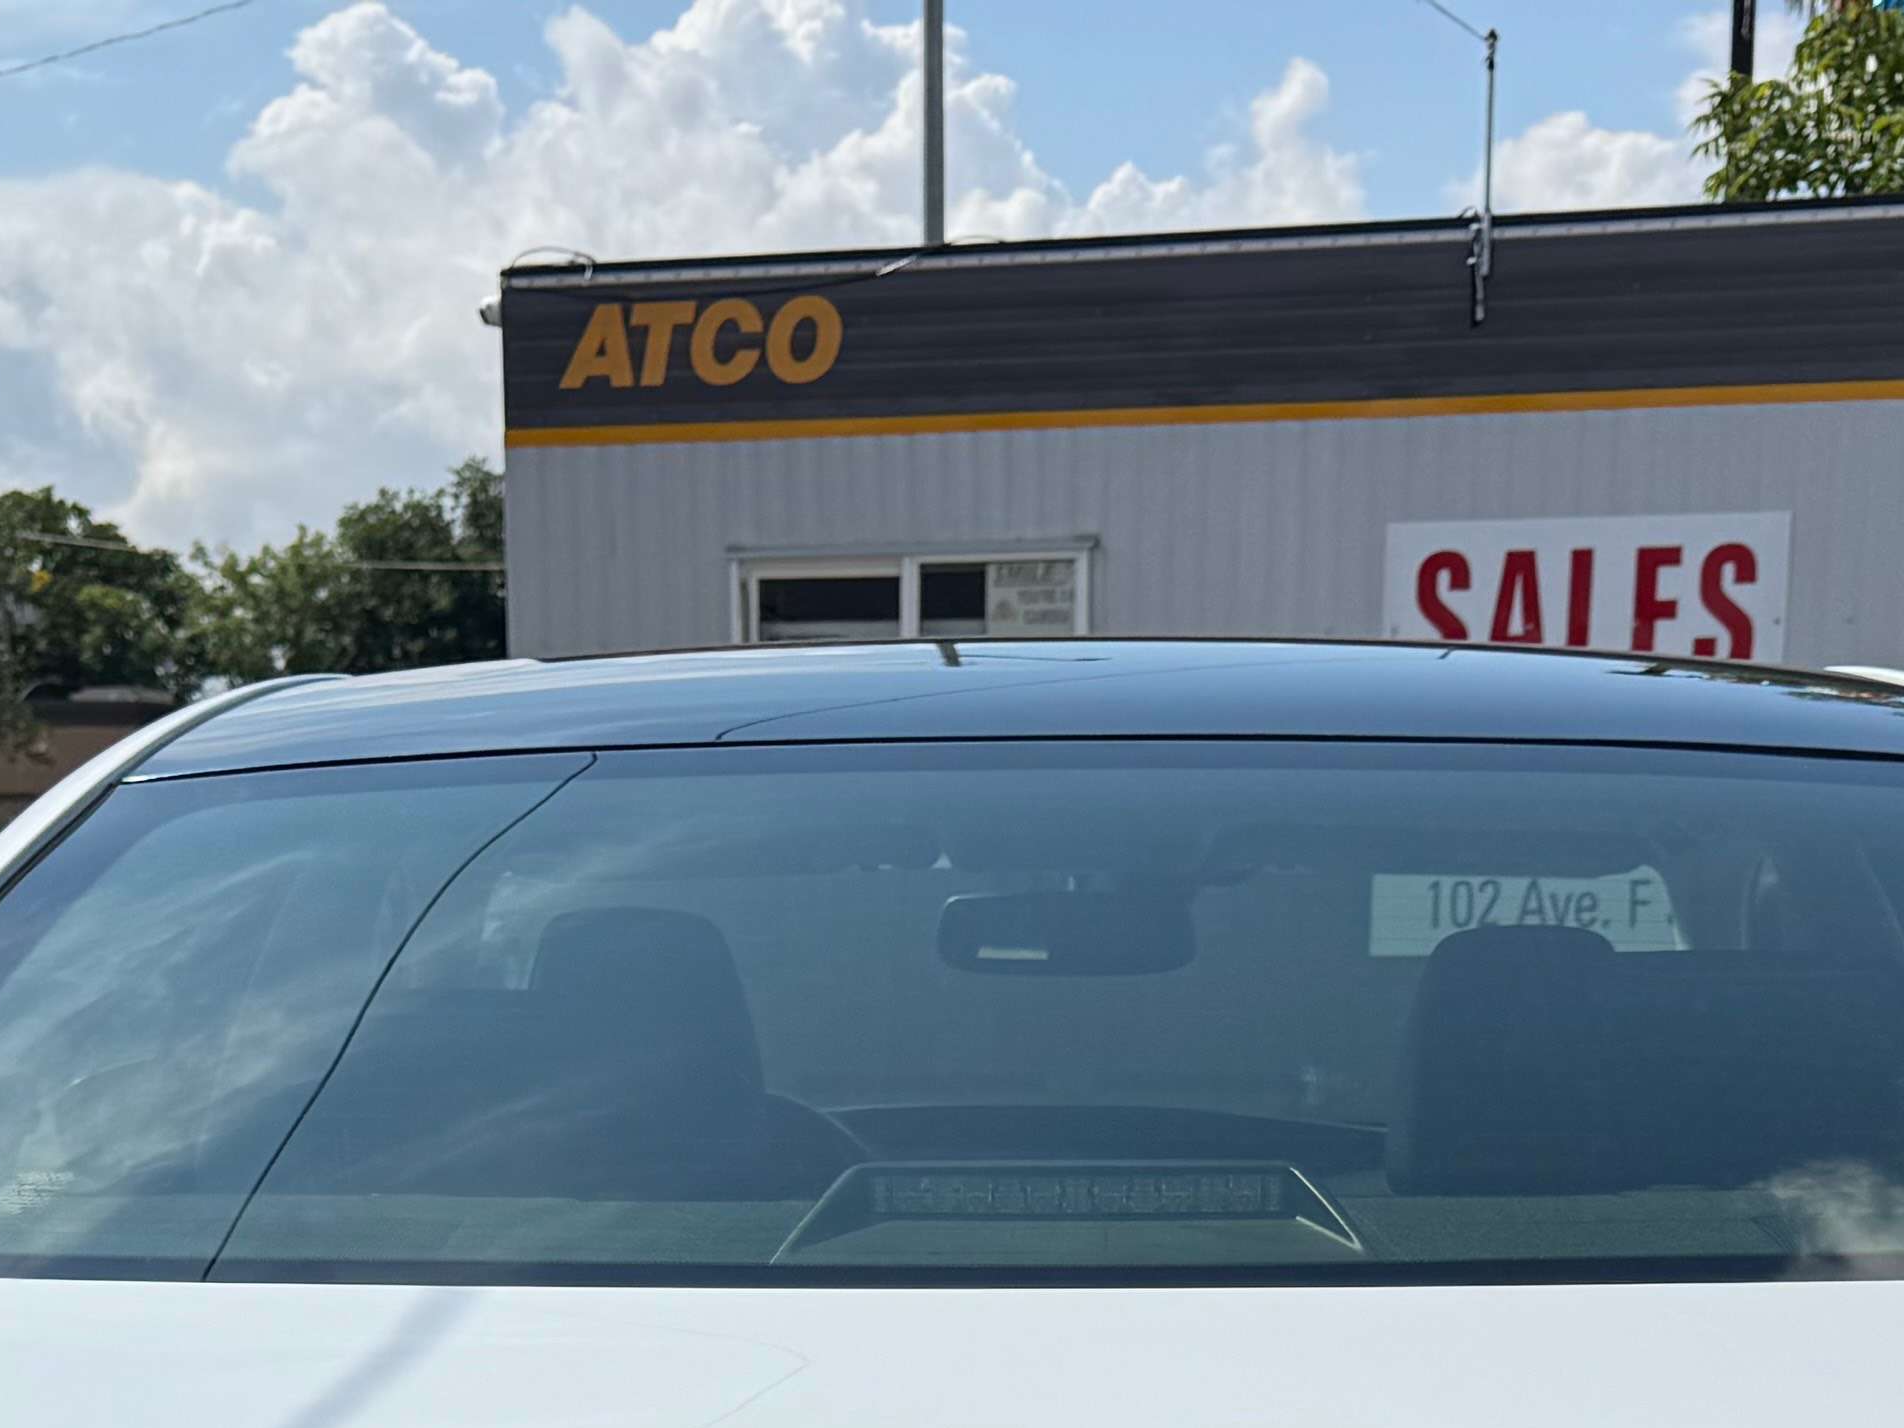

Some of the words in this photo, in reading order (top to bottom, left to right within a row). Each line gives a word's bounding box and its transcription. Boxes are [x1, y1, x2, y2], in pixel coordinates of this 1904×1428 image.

[559, 294, 844, 390] ATCO
[1427, 879, 1501, 929] 102
[1516, 877, 1612, 929] Ave.
